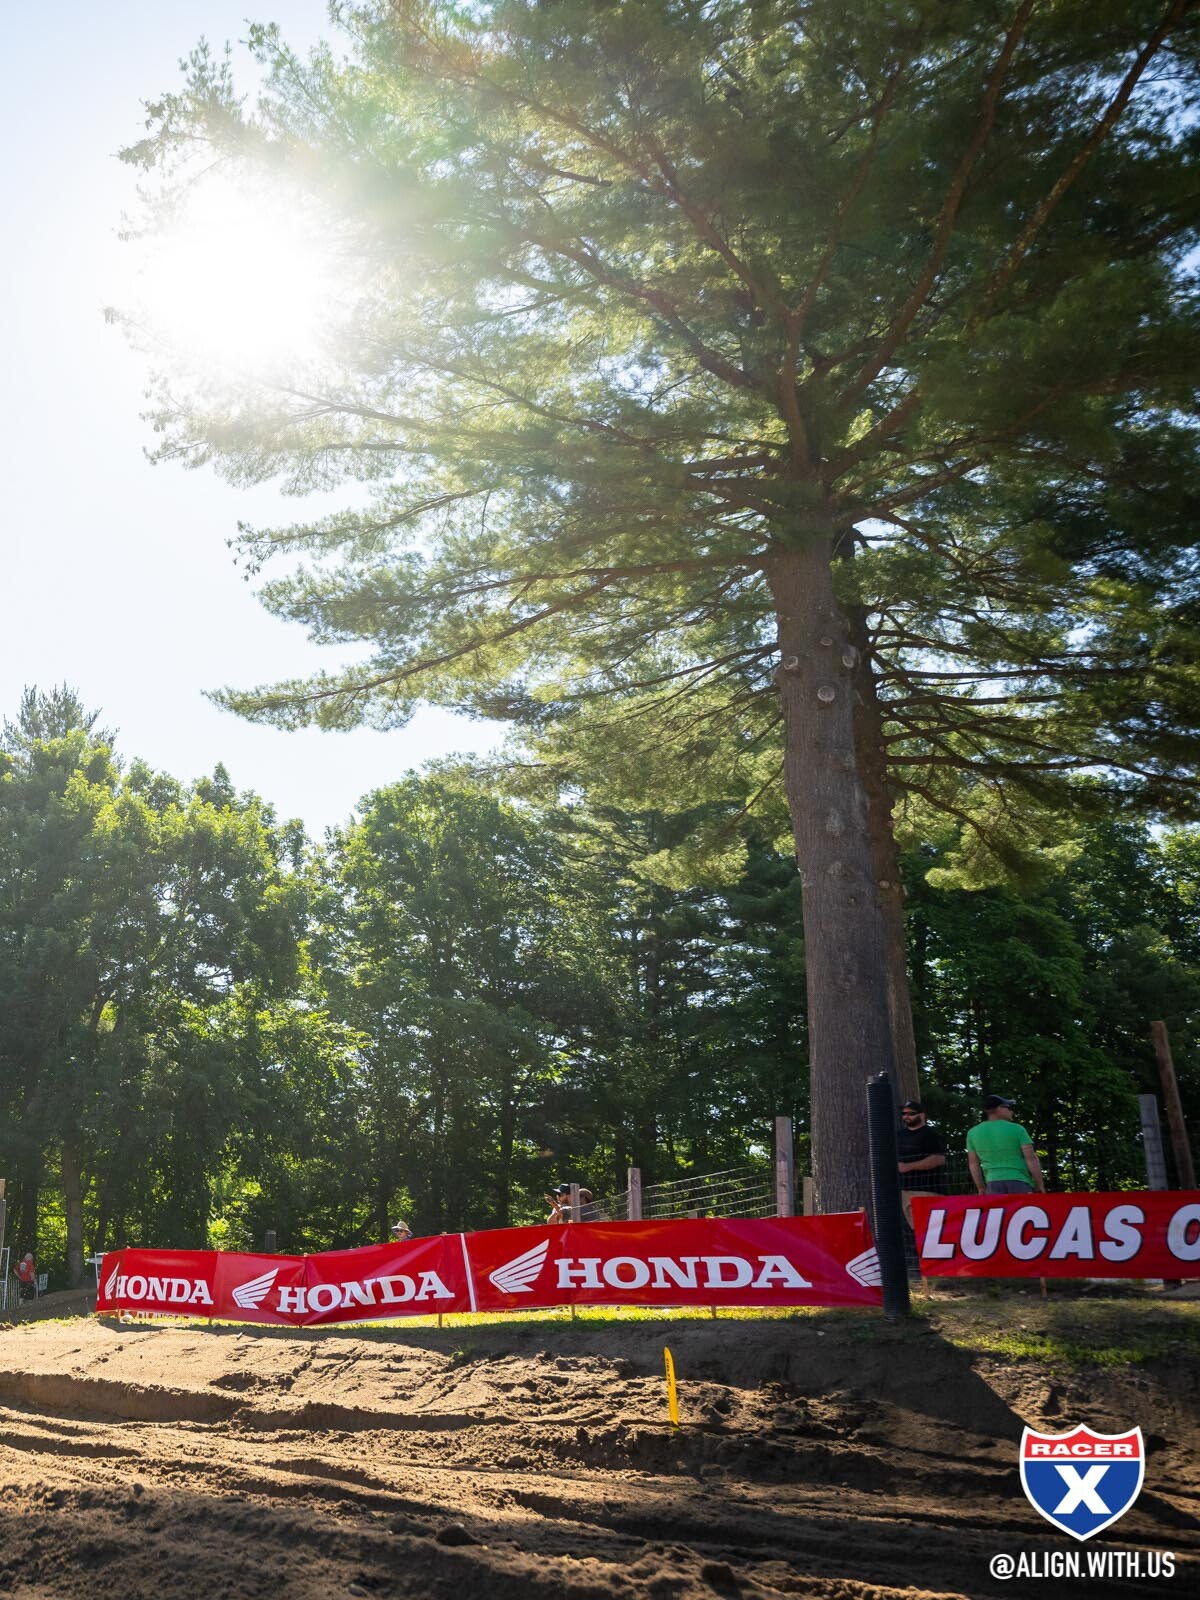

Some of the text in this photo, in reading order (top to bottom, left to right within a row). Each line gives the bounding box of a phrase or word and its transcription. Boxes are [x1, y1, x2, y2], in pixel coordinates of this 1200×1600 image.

[921, 1204, 1145, 1262] LUCAS
[116, 1275, 214, 1305] HONDA
[554, 1255, 813, 1289] HONDA
[276, 1270, 454, 1313] HONDA
